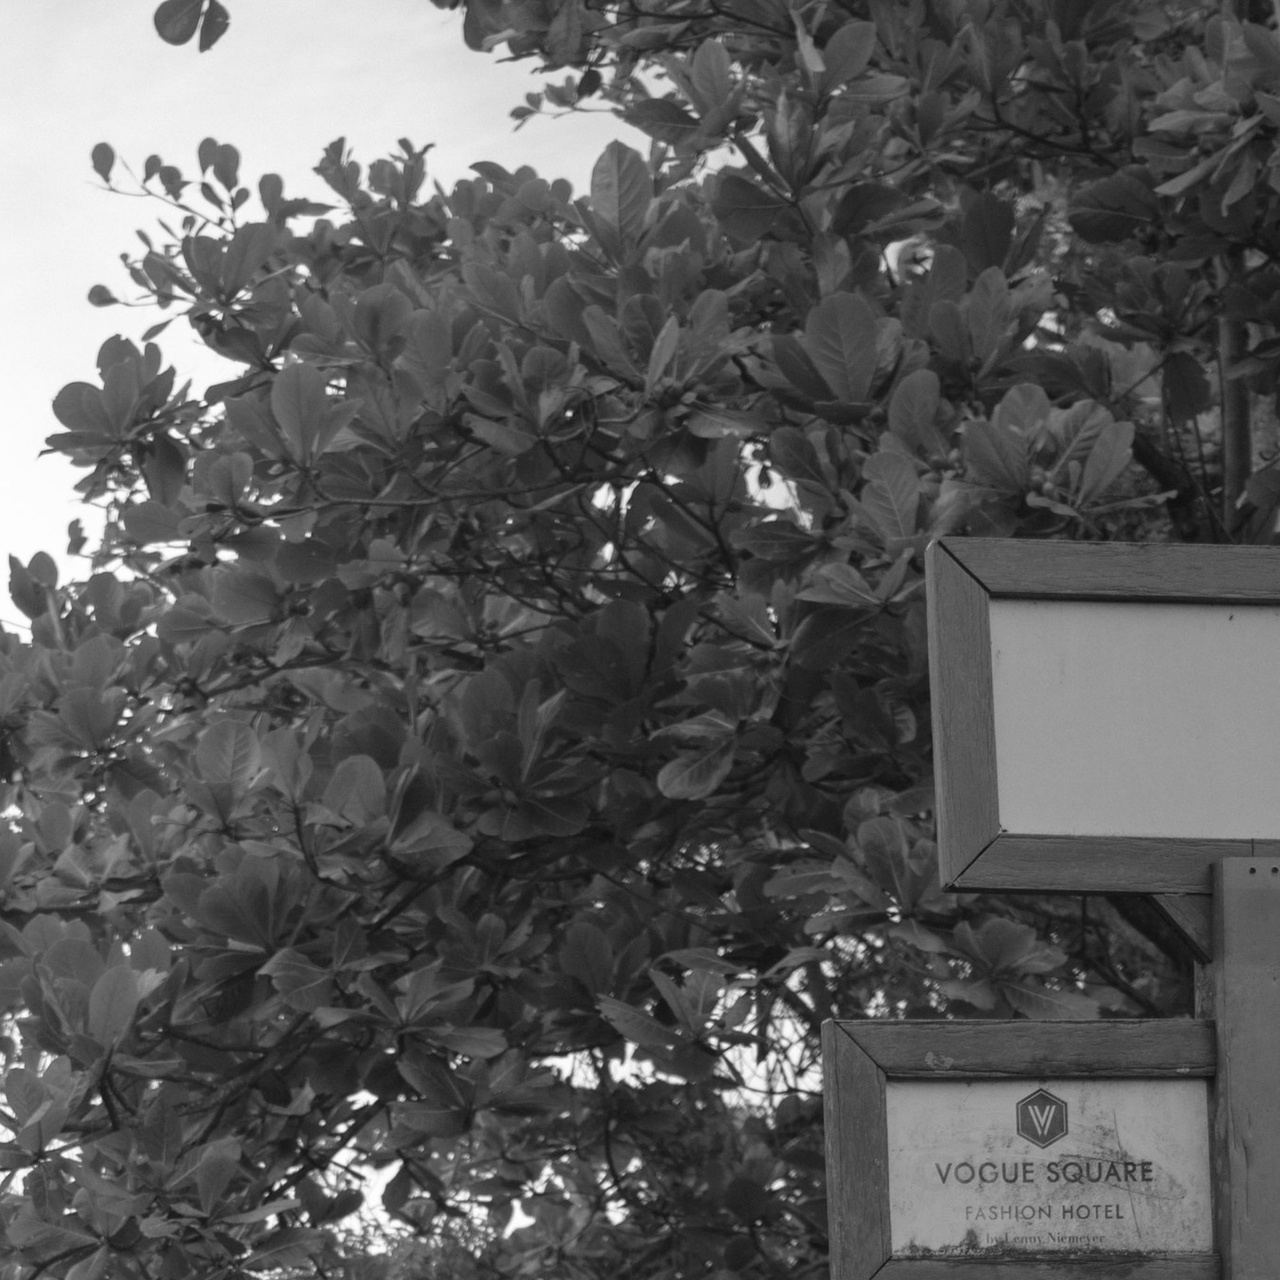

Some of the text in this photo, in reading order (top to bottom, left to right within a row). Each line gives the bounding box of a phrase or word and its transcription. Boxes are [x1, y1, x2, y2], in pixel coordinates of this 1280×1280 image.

[934, 1160, 1154, 1185] VOGUE SQUARE
[965, 1204, 1124, 1221] FASHION HOTEL
[986, 1231, 1106, 1247] by Lenny Niemeyer
